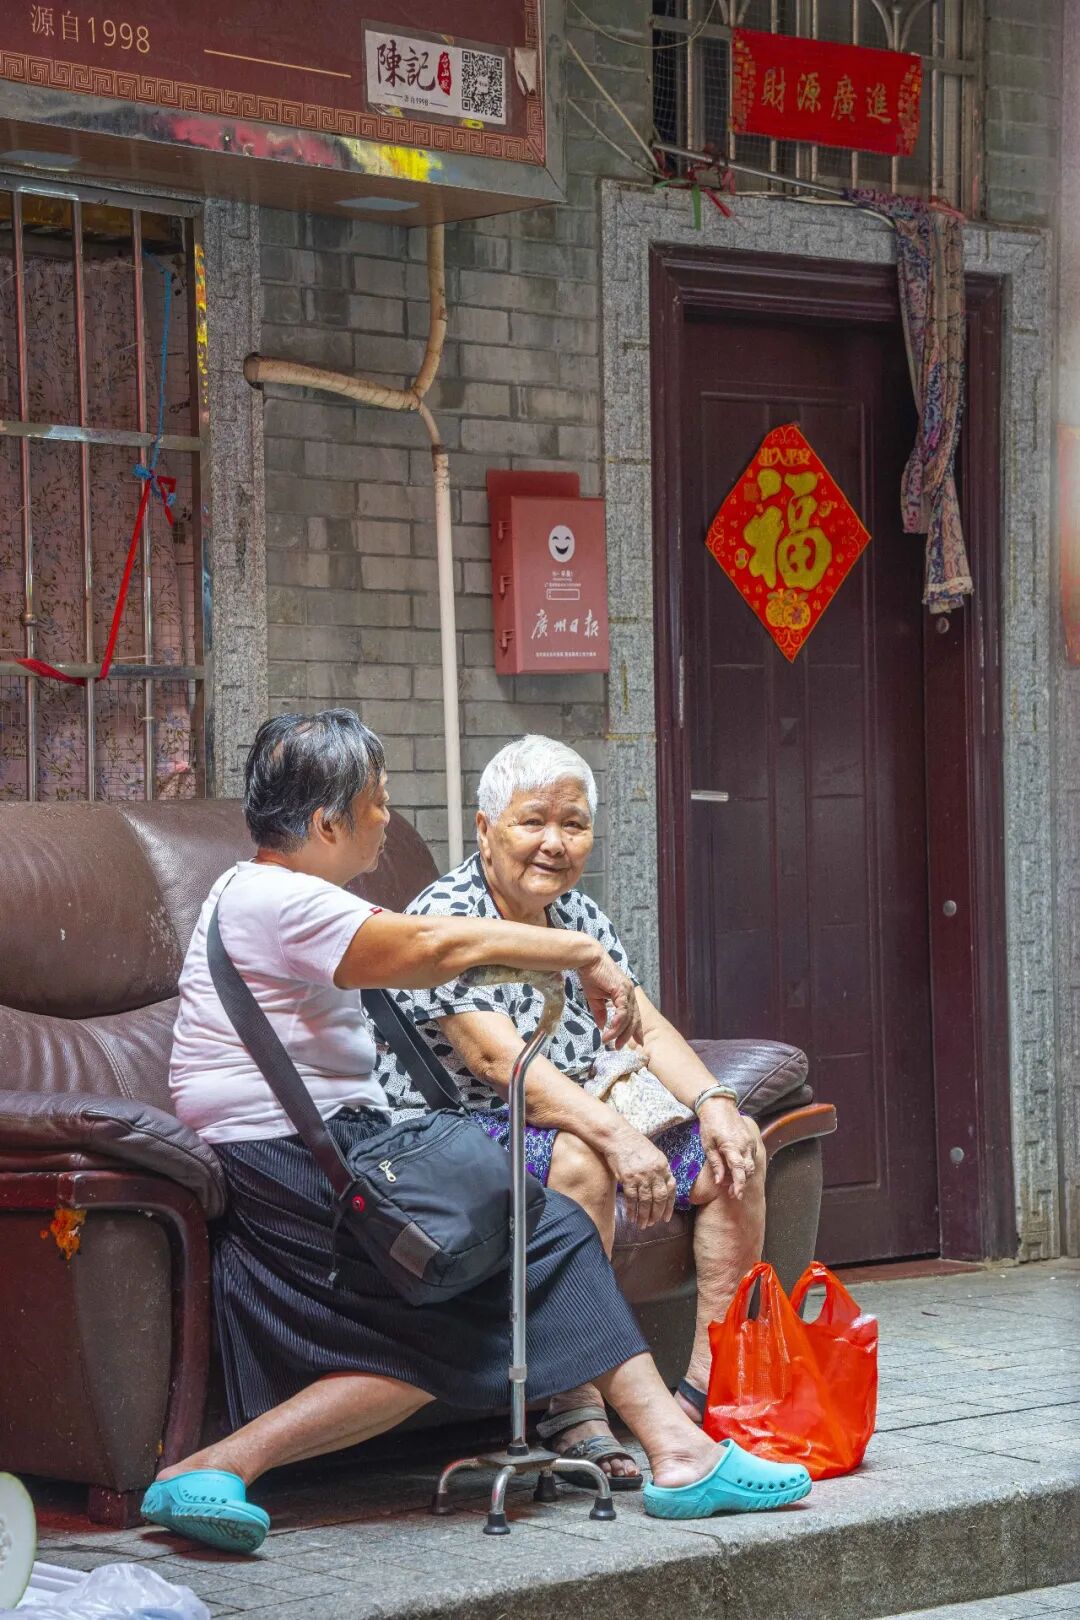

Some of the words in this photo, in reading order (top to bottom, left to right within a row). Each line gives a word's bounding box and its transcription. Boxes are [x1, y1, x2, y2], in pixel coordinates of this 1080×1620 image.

[30, 4, 150, 53] 源自1998
[376, 39, 436, 91] 陳記
[761, 66, 893, 124] 財源廣進
[743, 468, 832, 590] 福
